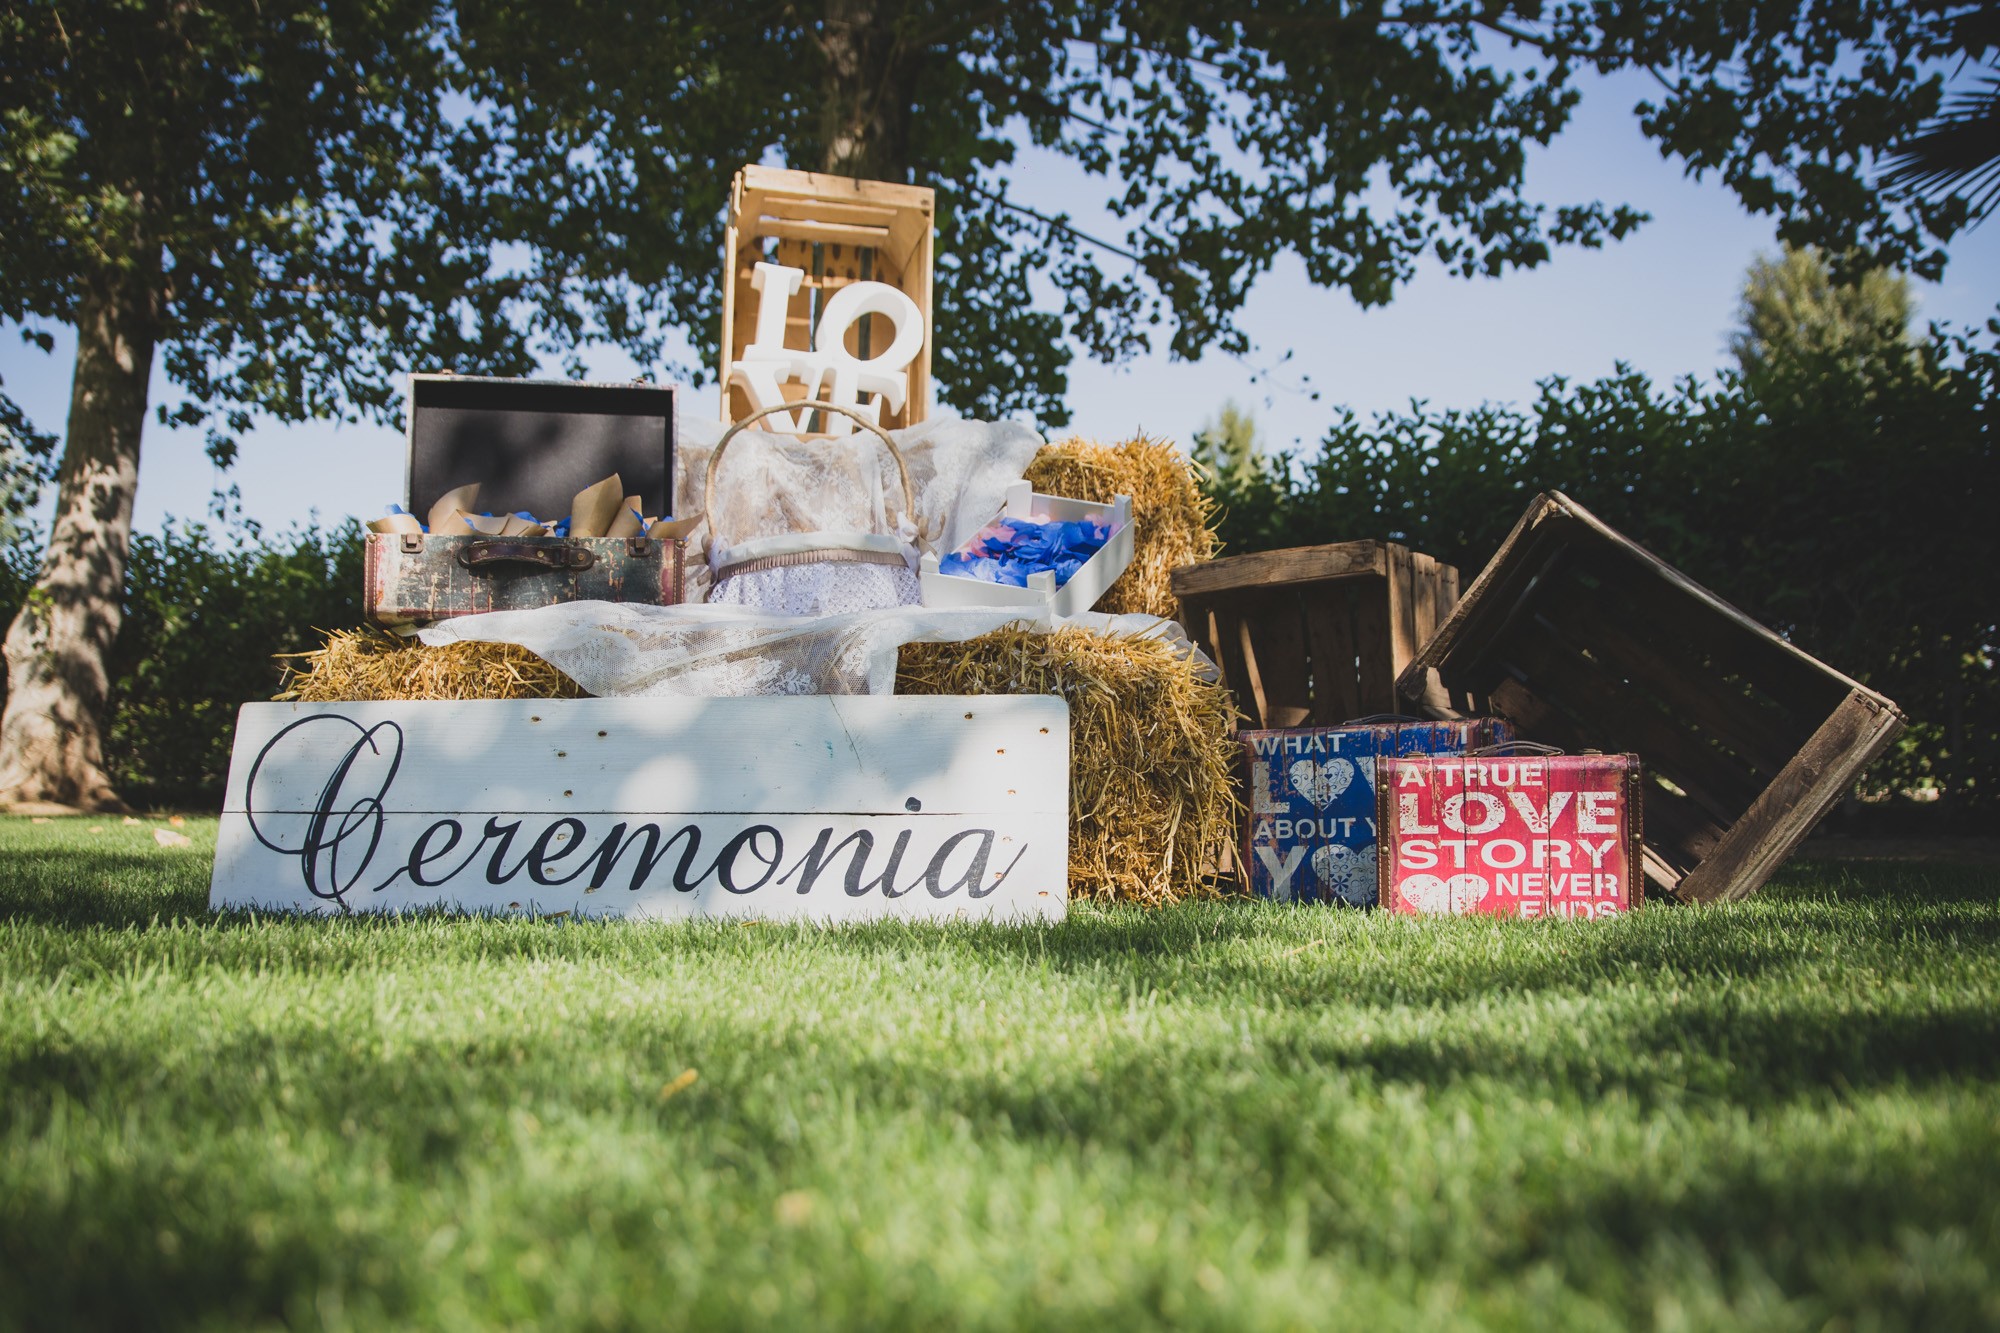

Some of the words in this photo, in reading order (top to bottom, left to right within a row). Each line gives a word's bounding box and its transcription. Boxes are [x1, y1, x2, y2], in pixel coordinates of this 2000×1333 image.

[1251, 733, 1347, 756] WHAT
[1399, 765, 1426, 787] A
[1437, 764, 1543, 787] TRUE
[245, 713, 1028, 911] Ceremonia
[1399, 791, 1617, 835] LOVE
[1254, 817, 1356, 840] ABOUT
[1399, 839, 1617, 869] STORY
[1495, 873, 1618, 897] NEVER
